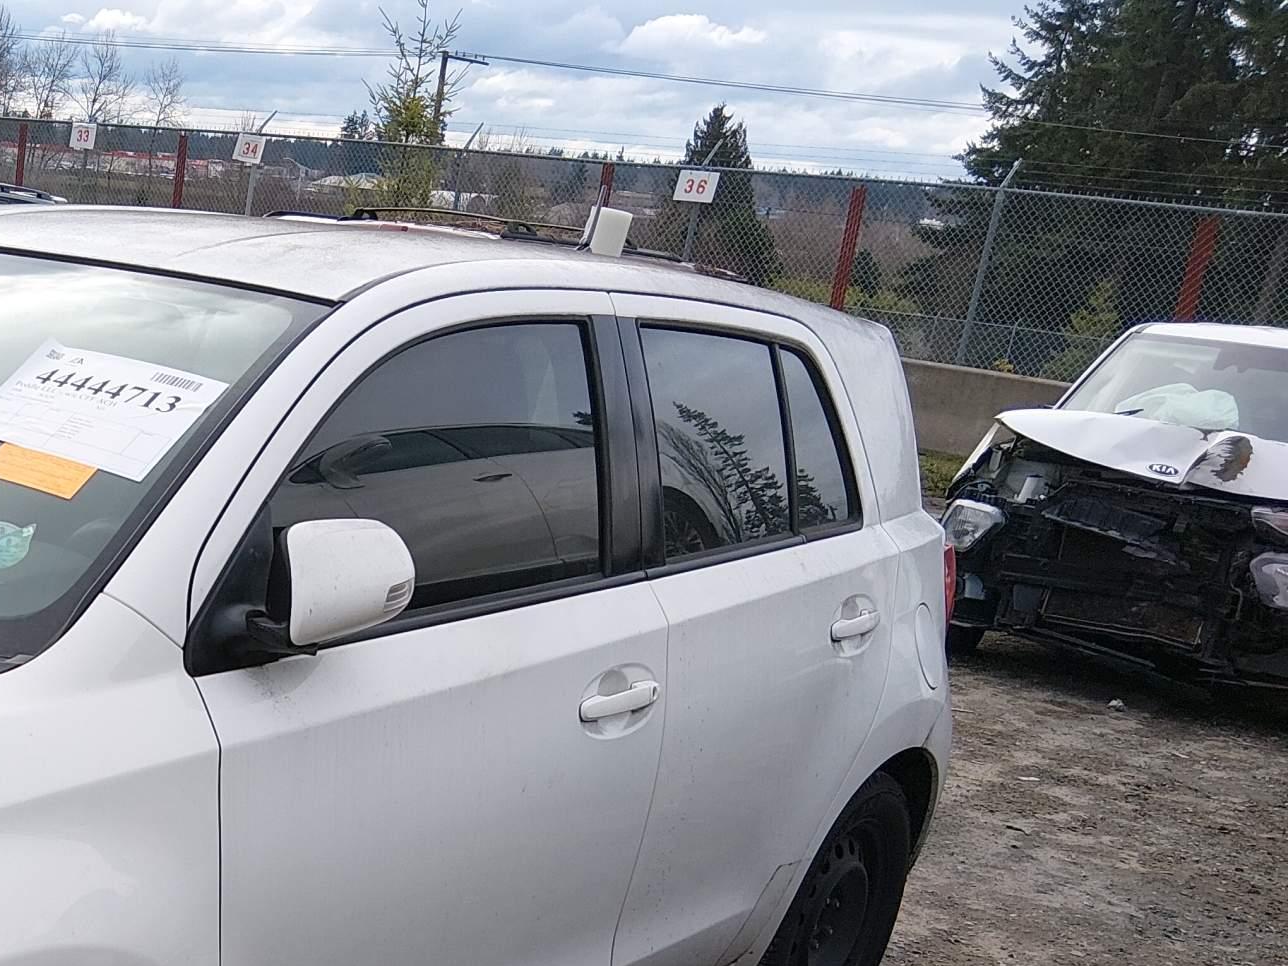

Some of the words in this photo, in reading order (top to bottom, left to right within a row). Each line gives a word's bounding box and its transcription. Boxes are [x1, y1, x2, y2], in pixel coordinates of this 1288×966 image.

[76, 129, 89, 142] 33
[242, 142, 258, 157] 34
[684, 178, 708, 194] 36
[35, 368, 182, 413] 44444713
[1152, 464, 1175, 475] KIA
